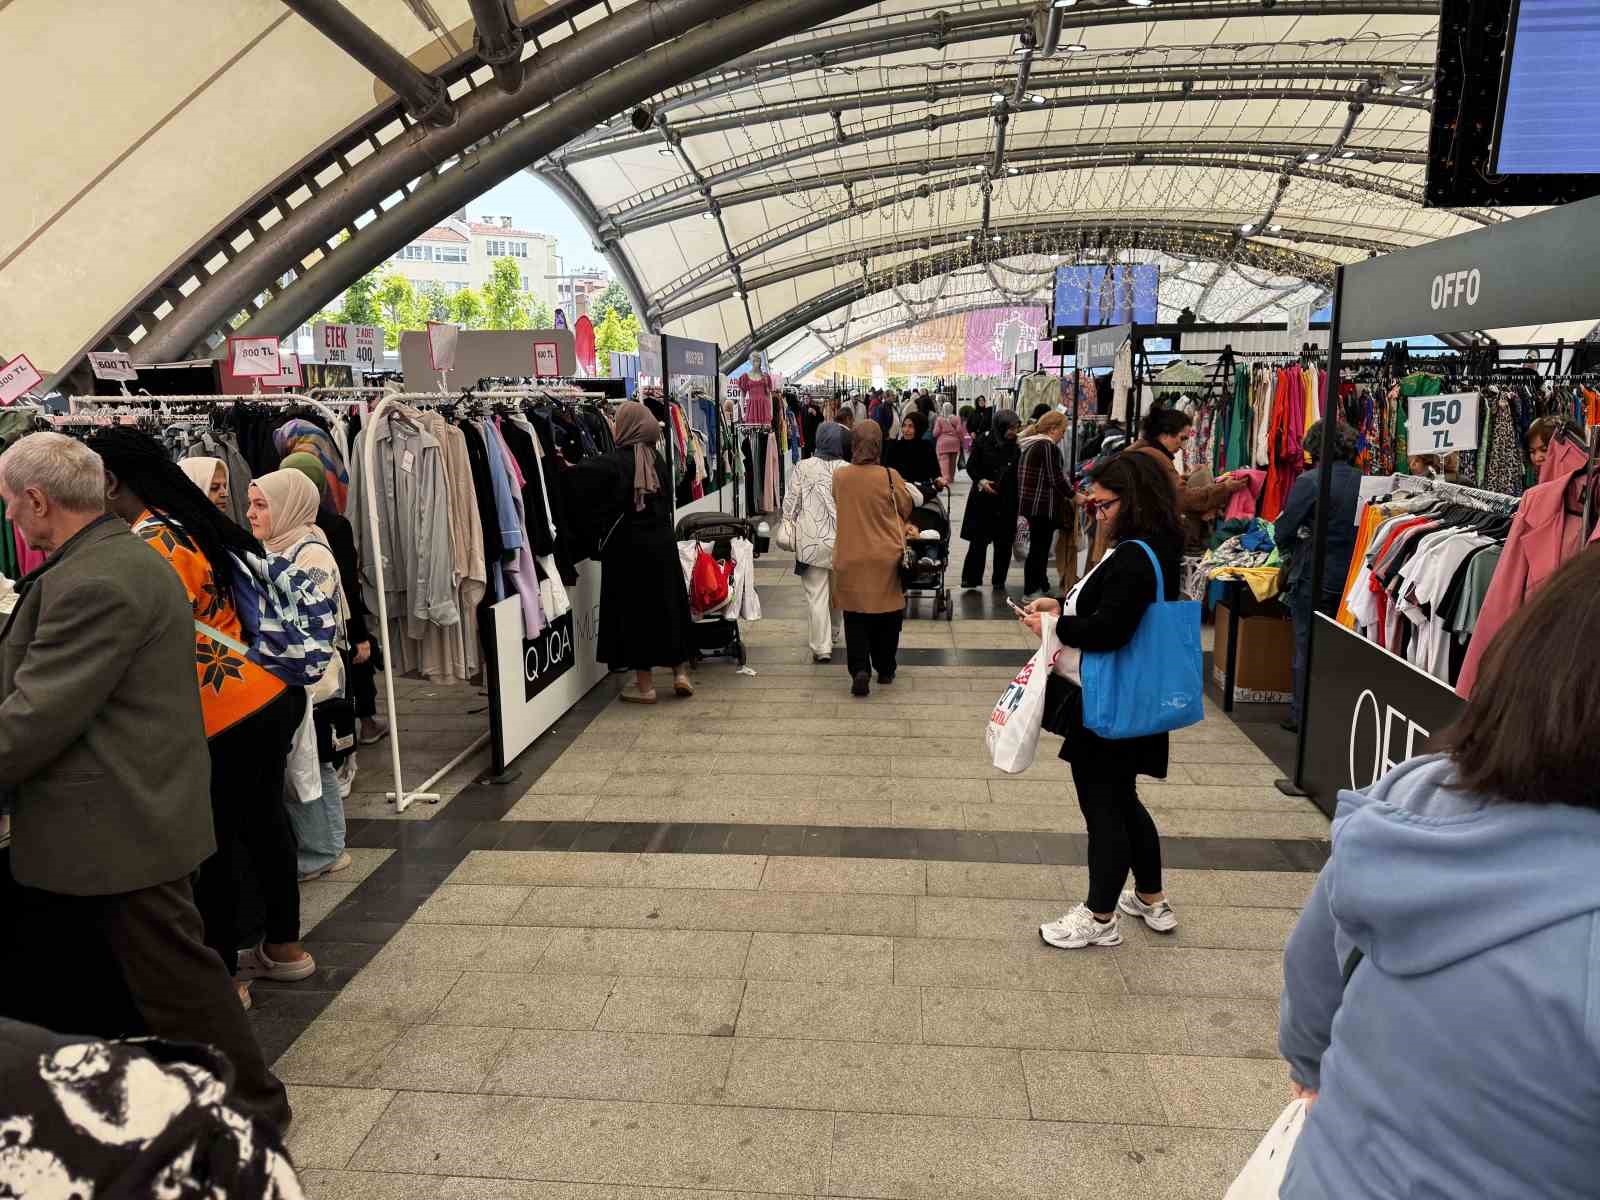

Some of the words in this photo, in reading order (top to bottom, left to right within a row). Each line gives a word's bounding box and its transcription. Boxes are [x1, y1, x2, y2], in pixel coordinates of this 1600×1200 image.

[1430, 268, 1481, 310] OFFO
[325, 325, 348, 349] ETEK
[261, 346, 275, 356] TL
[340, 350, 347, 361] TL
[356, 346, 373, 362] 400
[13, 365, 27, 375] TL
[282, 366, 294, 375] TL
[1422, 399, 1462, 427] 150
[1432, 429, 1454, 448] TL
[525, 646, 539, 682] Q
